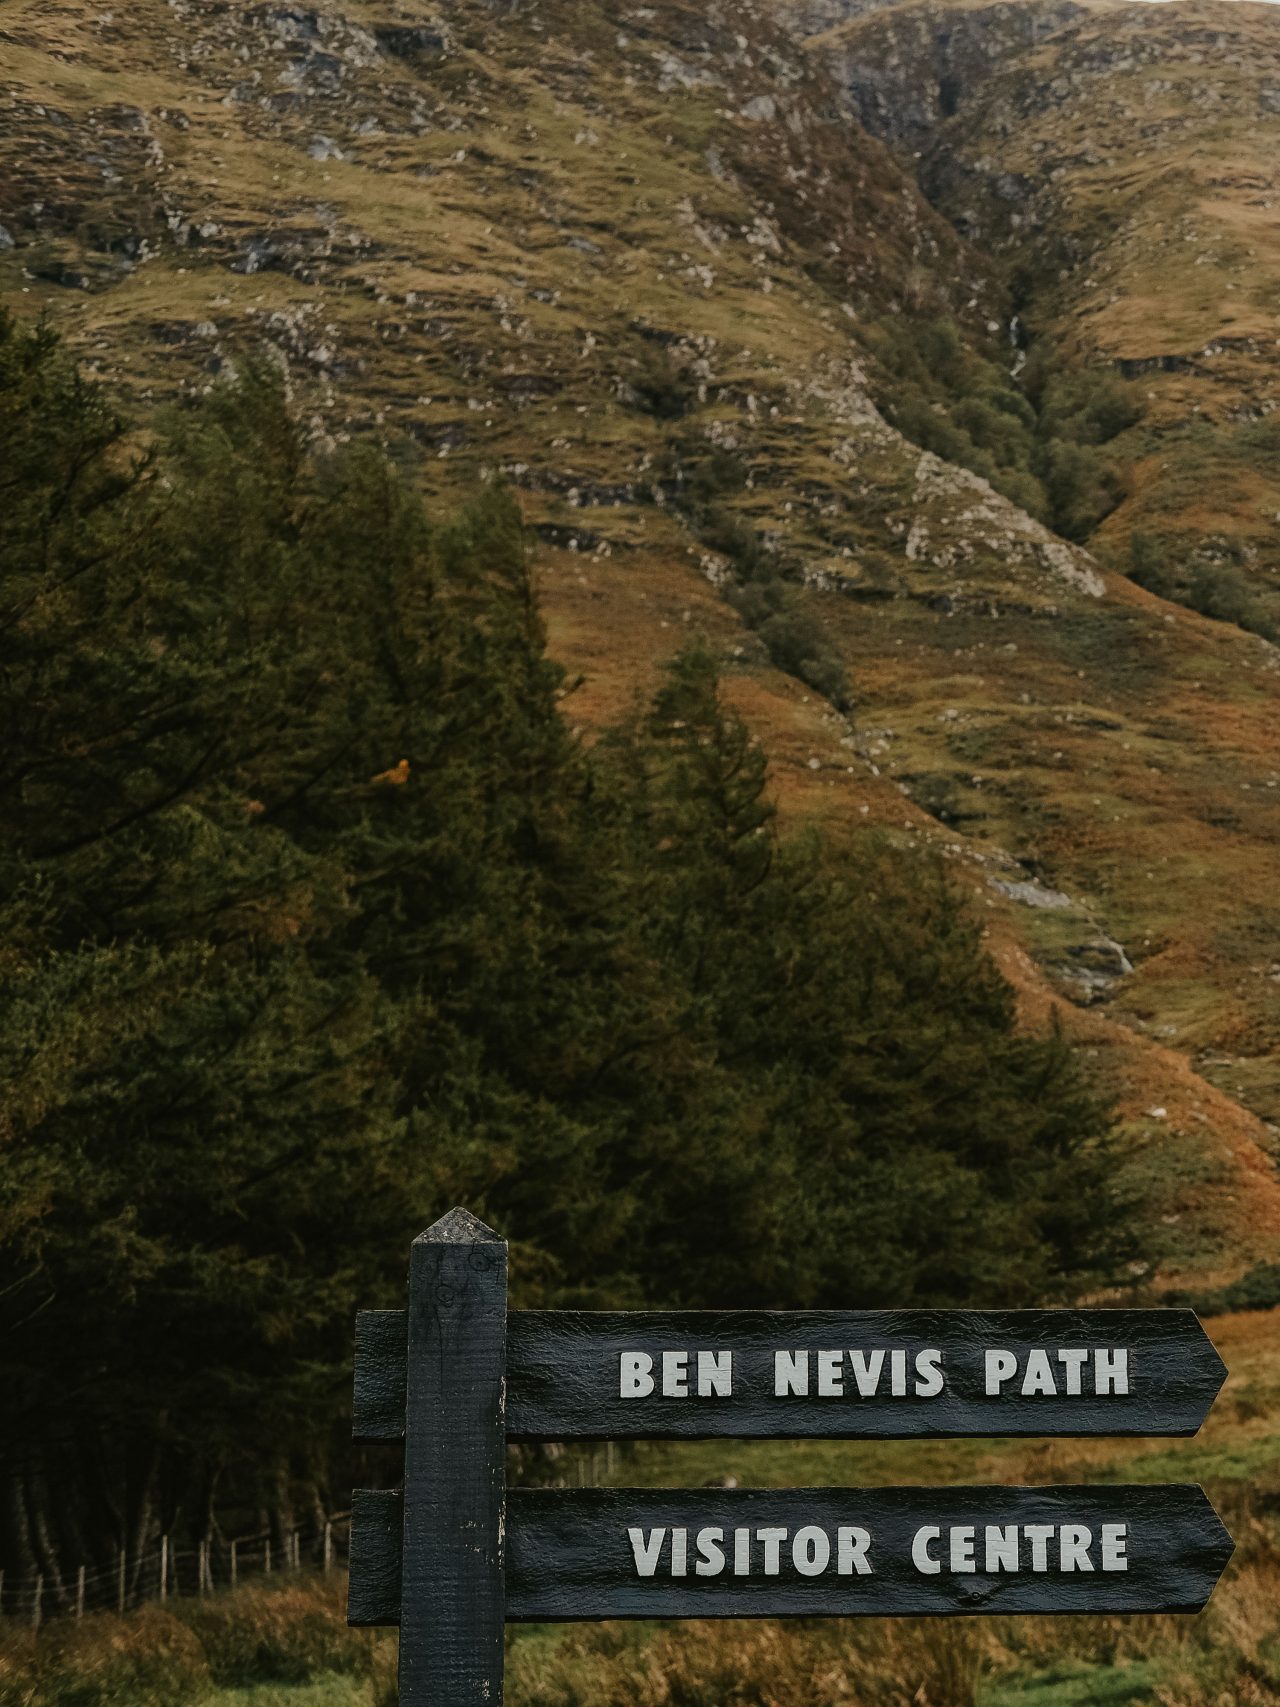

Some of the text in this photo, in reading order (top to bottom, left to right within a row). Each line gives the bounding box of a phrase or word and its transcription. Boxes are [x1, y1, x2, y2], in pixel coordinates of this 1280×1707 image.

[619, 1348, 1129, 1398] BEN NEVIS PATH
[627, 1523, 1128, 1577] VISITOR CENTRE
